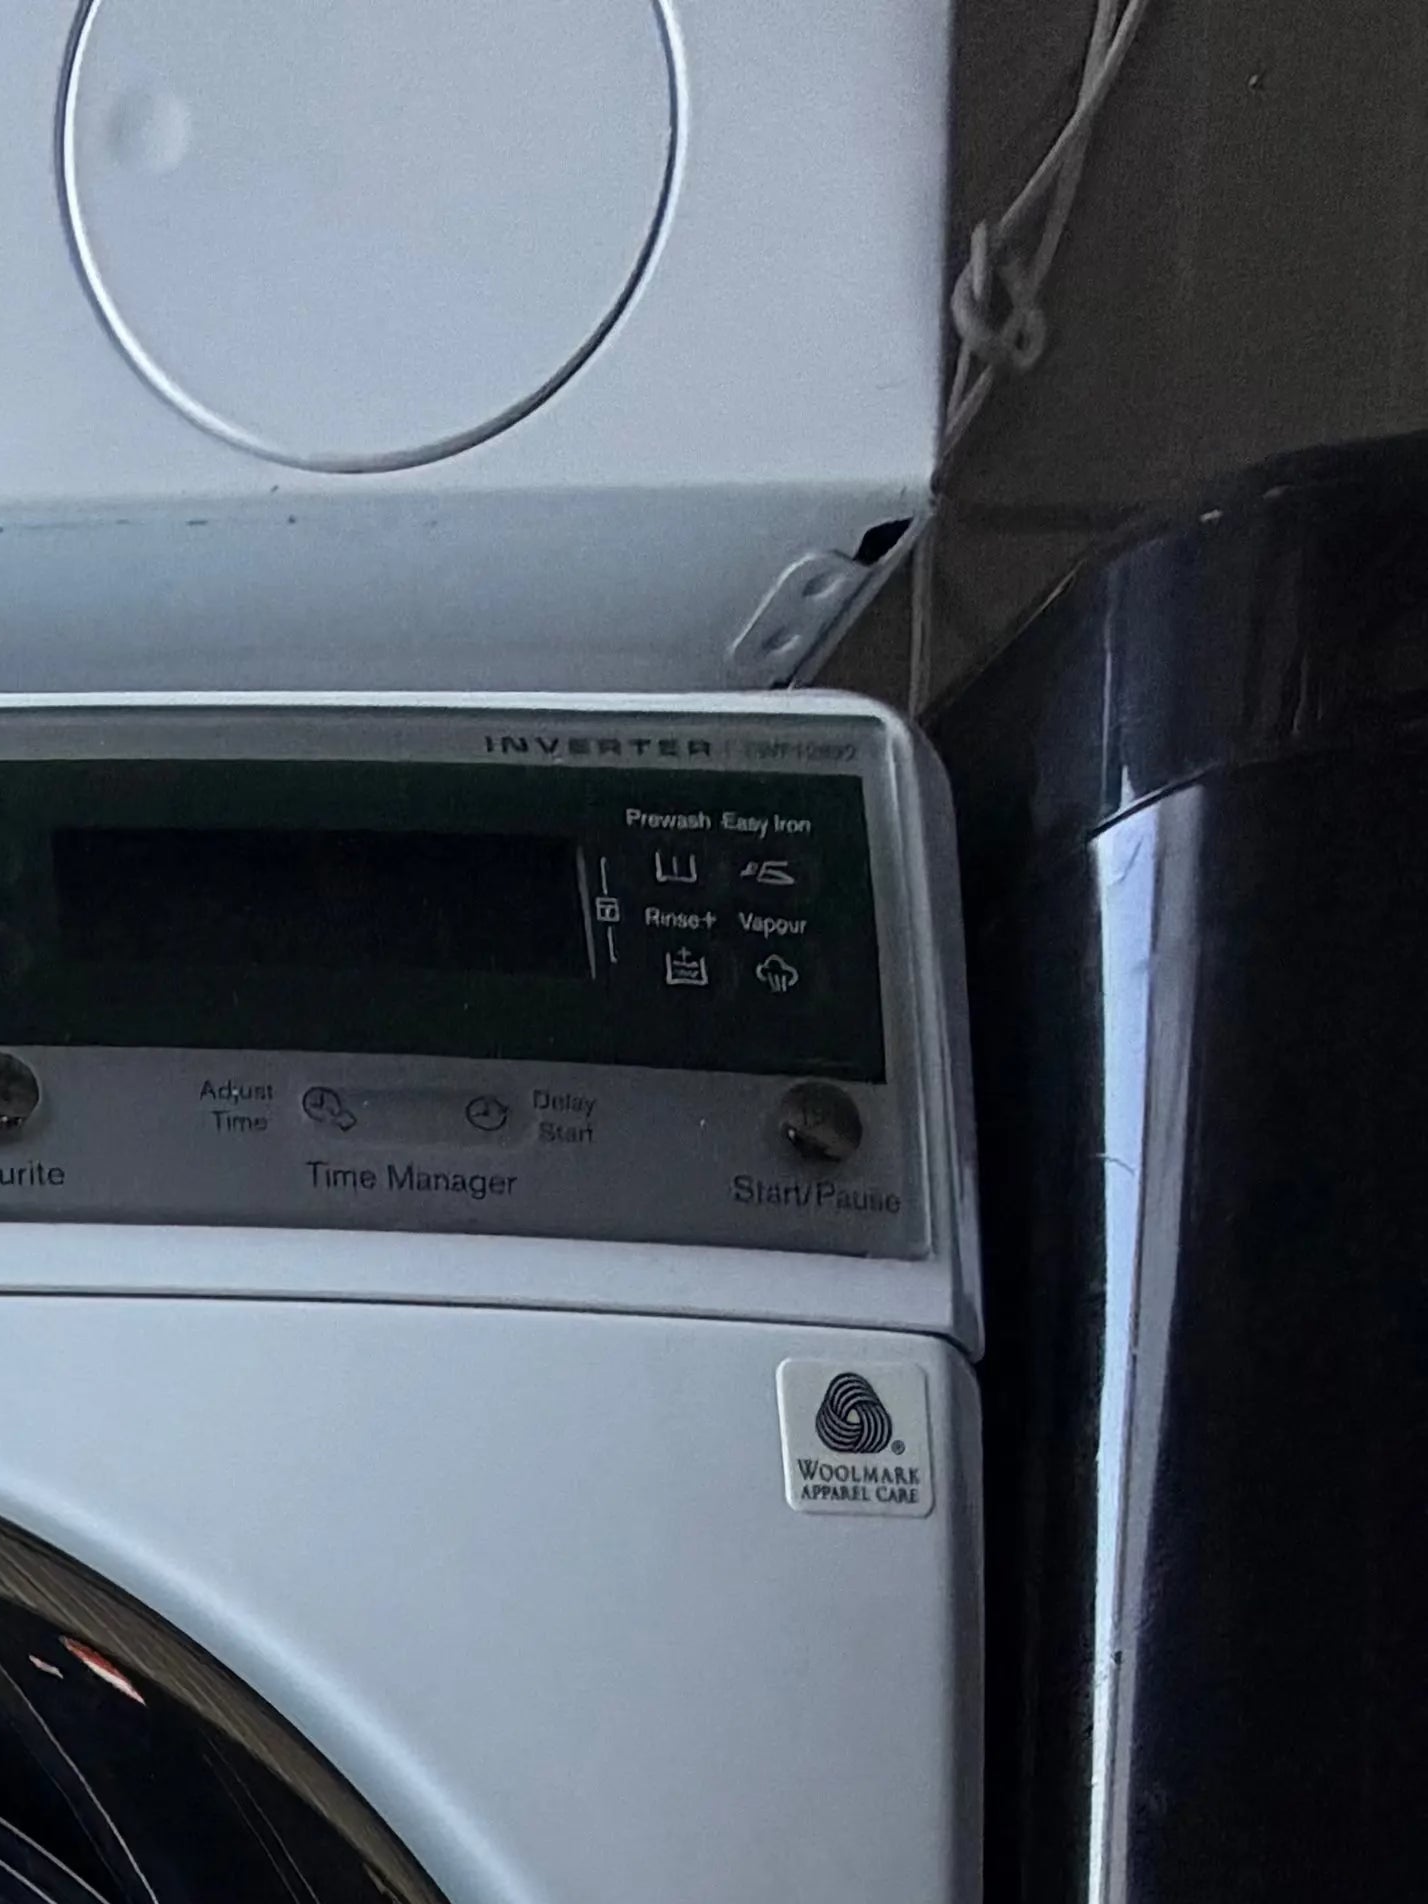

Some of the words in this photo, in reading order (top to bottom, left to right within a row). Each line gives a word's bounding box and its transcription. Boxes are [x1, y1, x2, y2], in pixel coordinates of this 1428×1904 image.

[485, 734, 711, 759] INVERTER
[625, 807, 711, 831] Prewash
[720, 810, 768, 839] Easy
[774, 813, 812, 833] Iron
[644, 906, 718, 930] Rinse+
[738, 911, 807, 939] Vapour
[199, 1078, 274, 1104] Adjust
[532, 1089, 597, 1118] Delay
[211, 1111, 268, 1132] Time
[537, 1121, 594, 1143] Start
[304, 1159, 376, 1191] Time
[387, 1163, 519, 1200] Manager
[733, 1174, 902, 1216] Start/Pause
[797, 1458, 921, 1486] WOOLMARK
[800, 1483, 870, 1503] APPAREL
[876, 1485, 920, 1504] CARE
